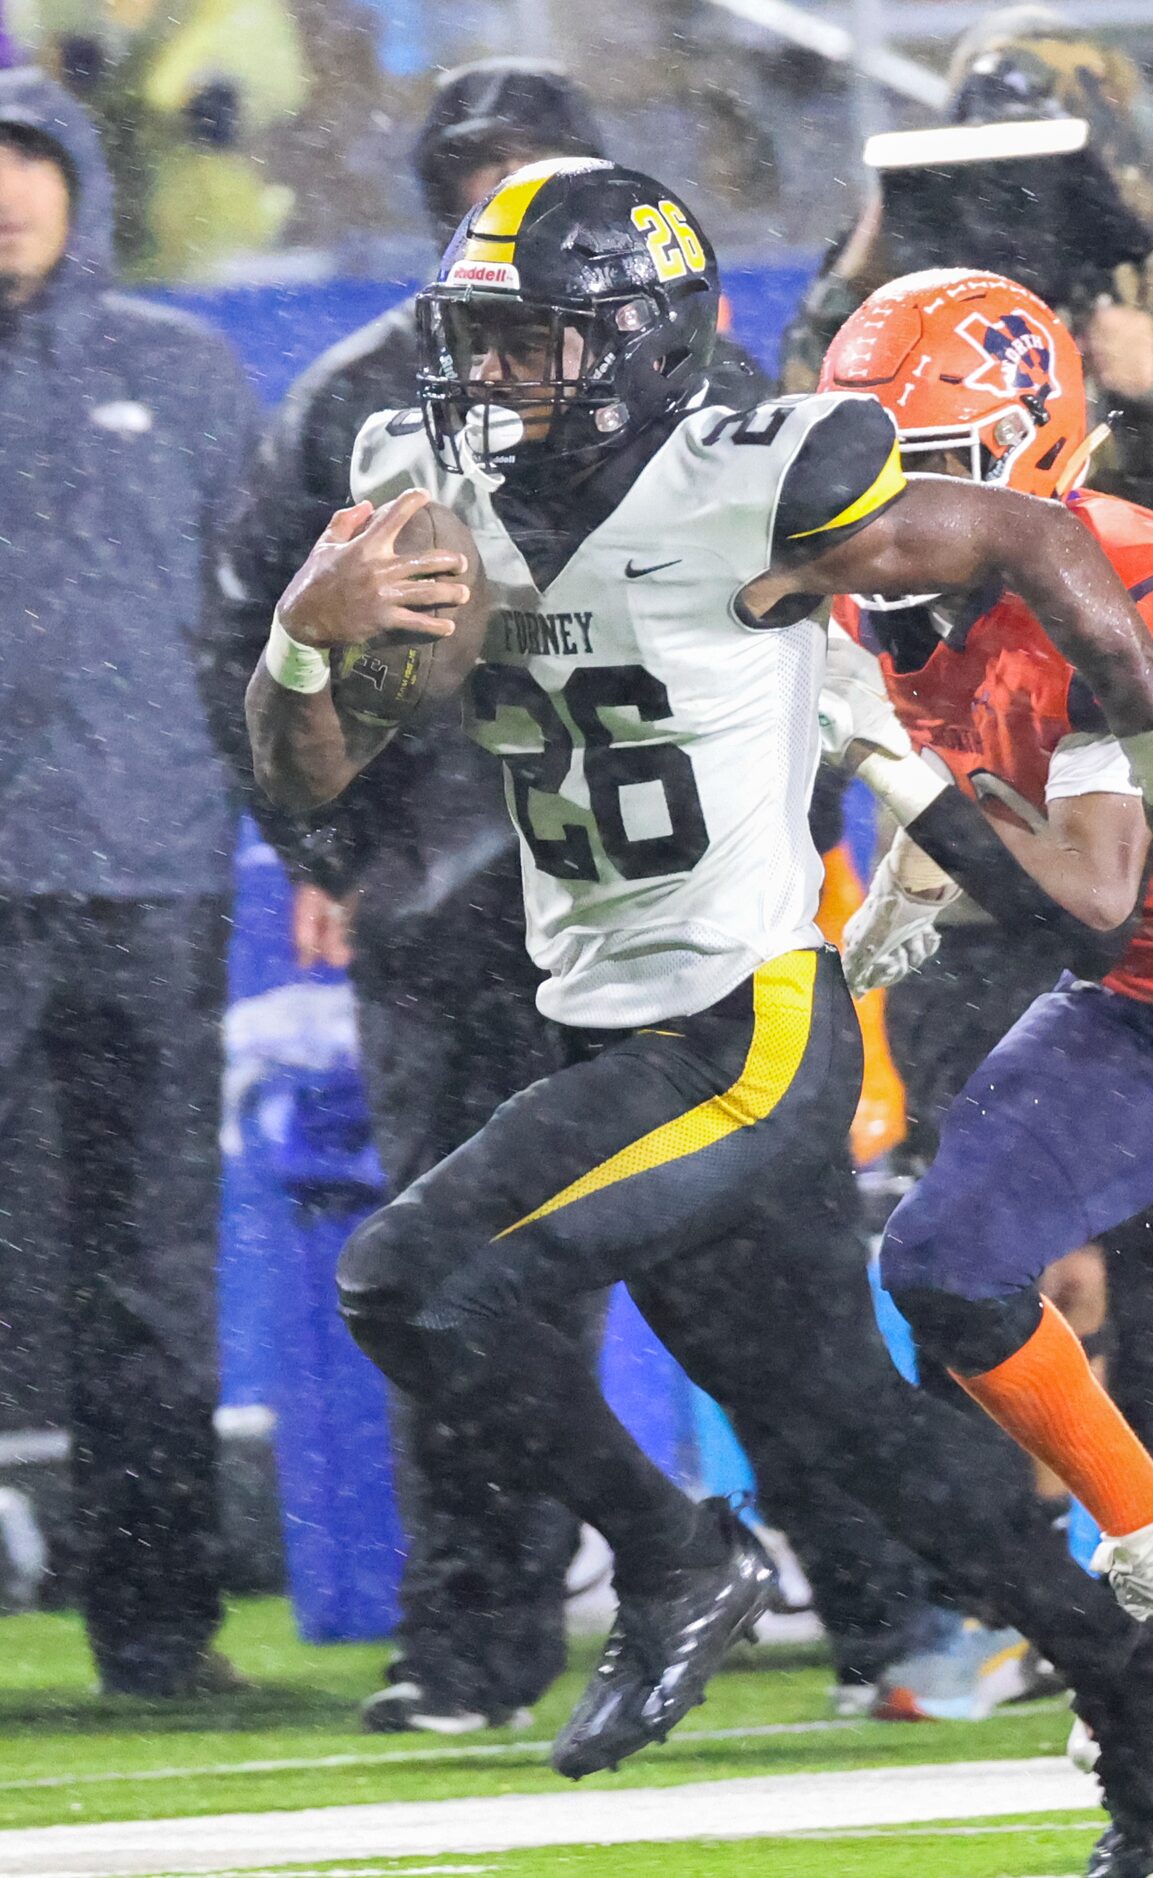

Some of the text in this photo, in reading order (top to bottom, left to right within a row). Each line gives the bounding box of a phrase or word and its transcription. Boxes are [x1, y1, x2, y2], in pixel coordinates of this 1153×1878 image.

[630, 200, 706, 282] 26
[501, 611, 594, 656] FORNEY
[469, 663, 711, 882] 26
